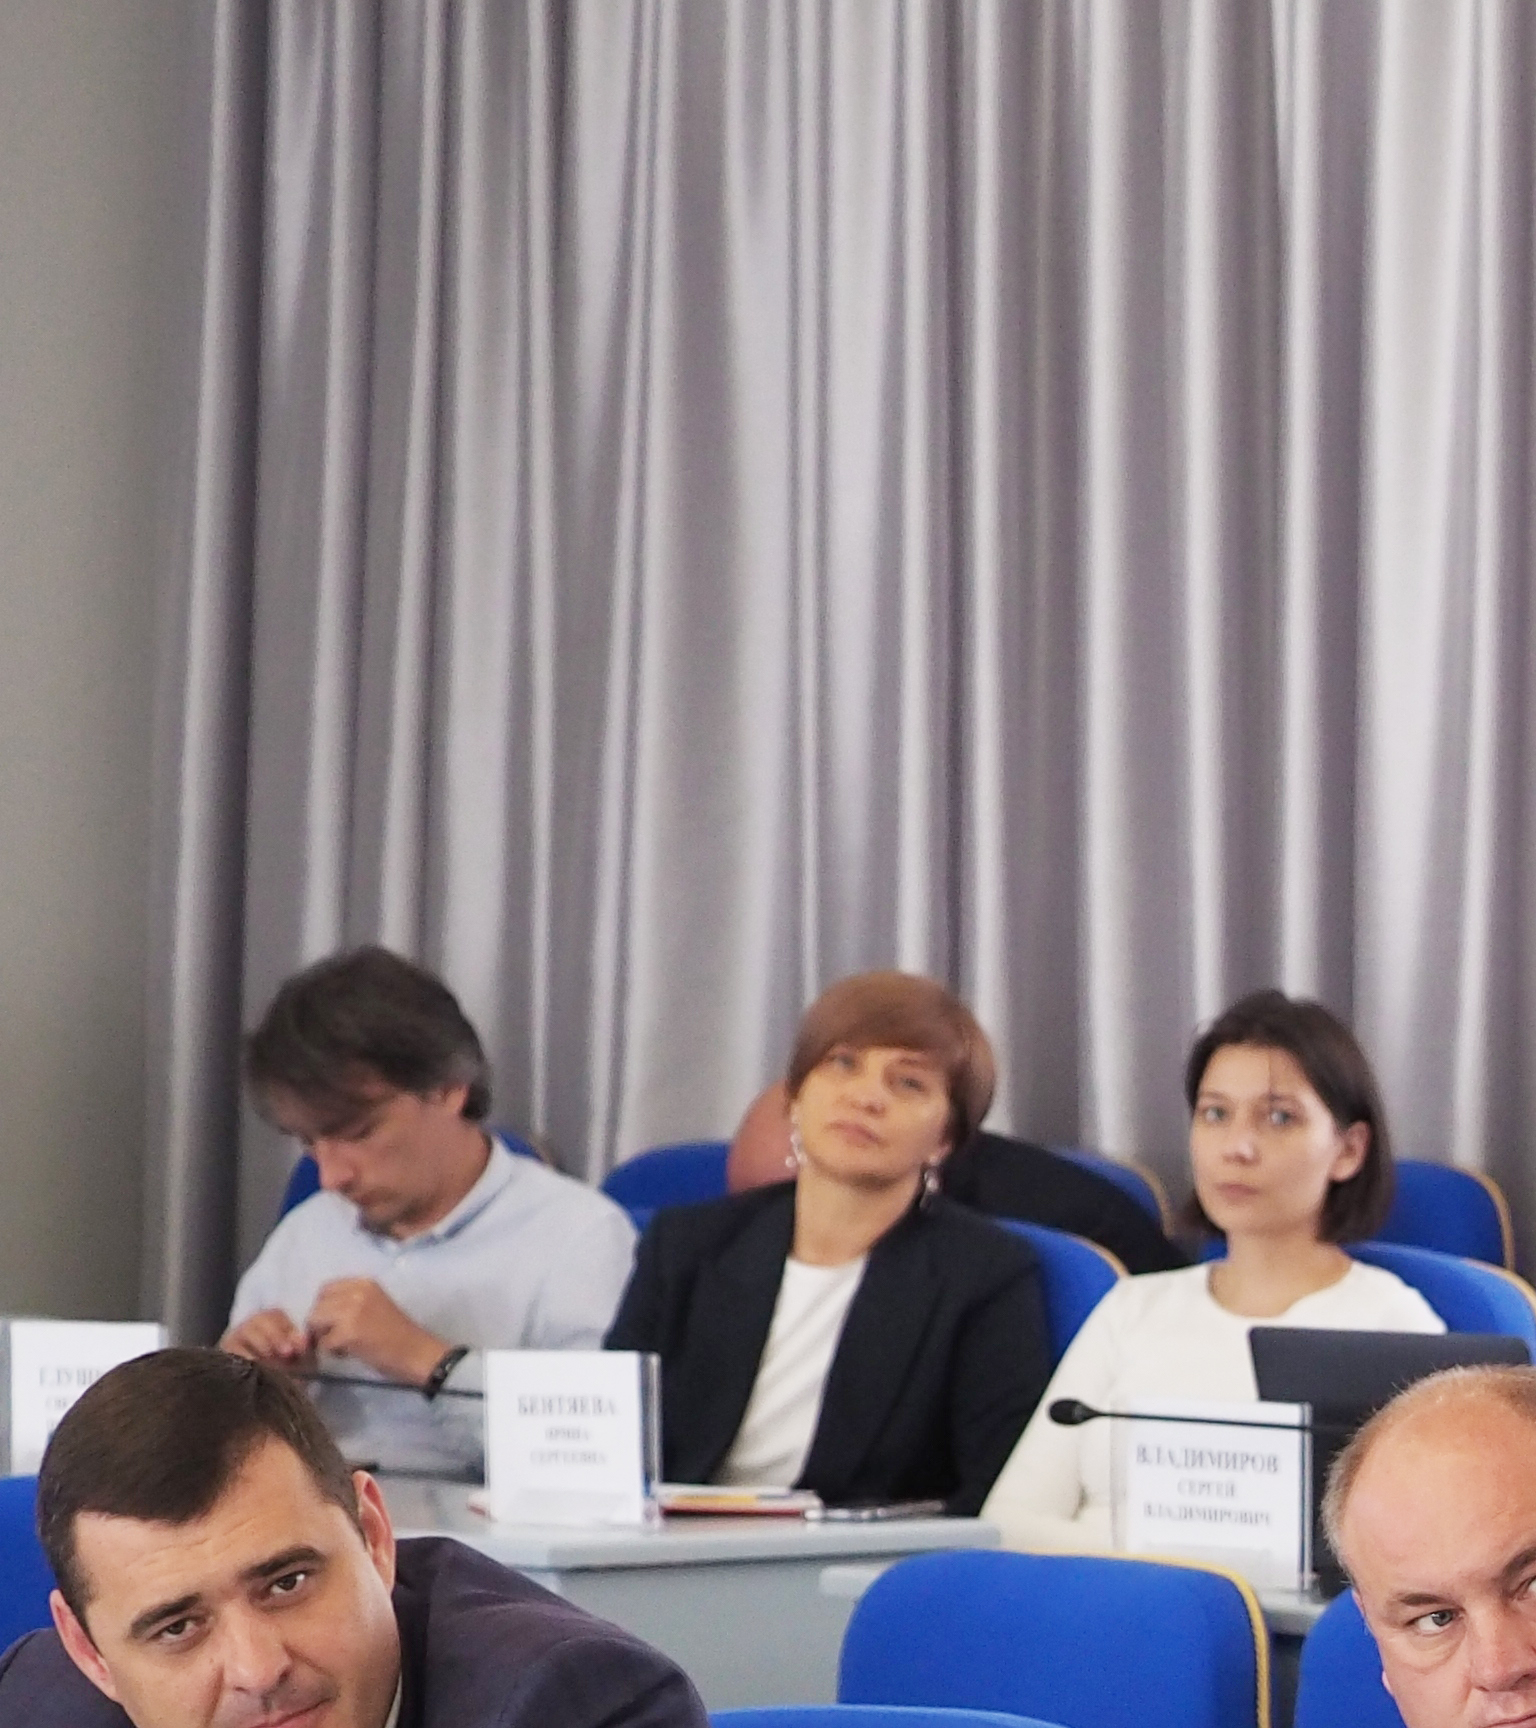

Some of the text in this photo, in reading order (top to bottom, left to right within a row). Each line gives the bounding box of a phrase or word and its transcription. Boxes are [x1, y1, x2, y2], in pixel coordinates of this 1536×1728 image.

[1136, 1444, 1279, 1474] ВЛАДИМИРОВ
[1177, 1479, 1236, 1498] СЕРГЕЙ
[1144, 1502, 1270, 1526] ВЛАДИМИРОВИЧ
